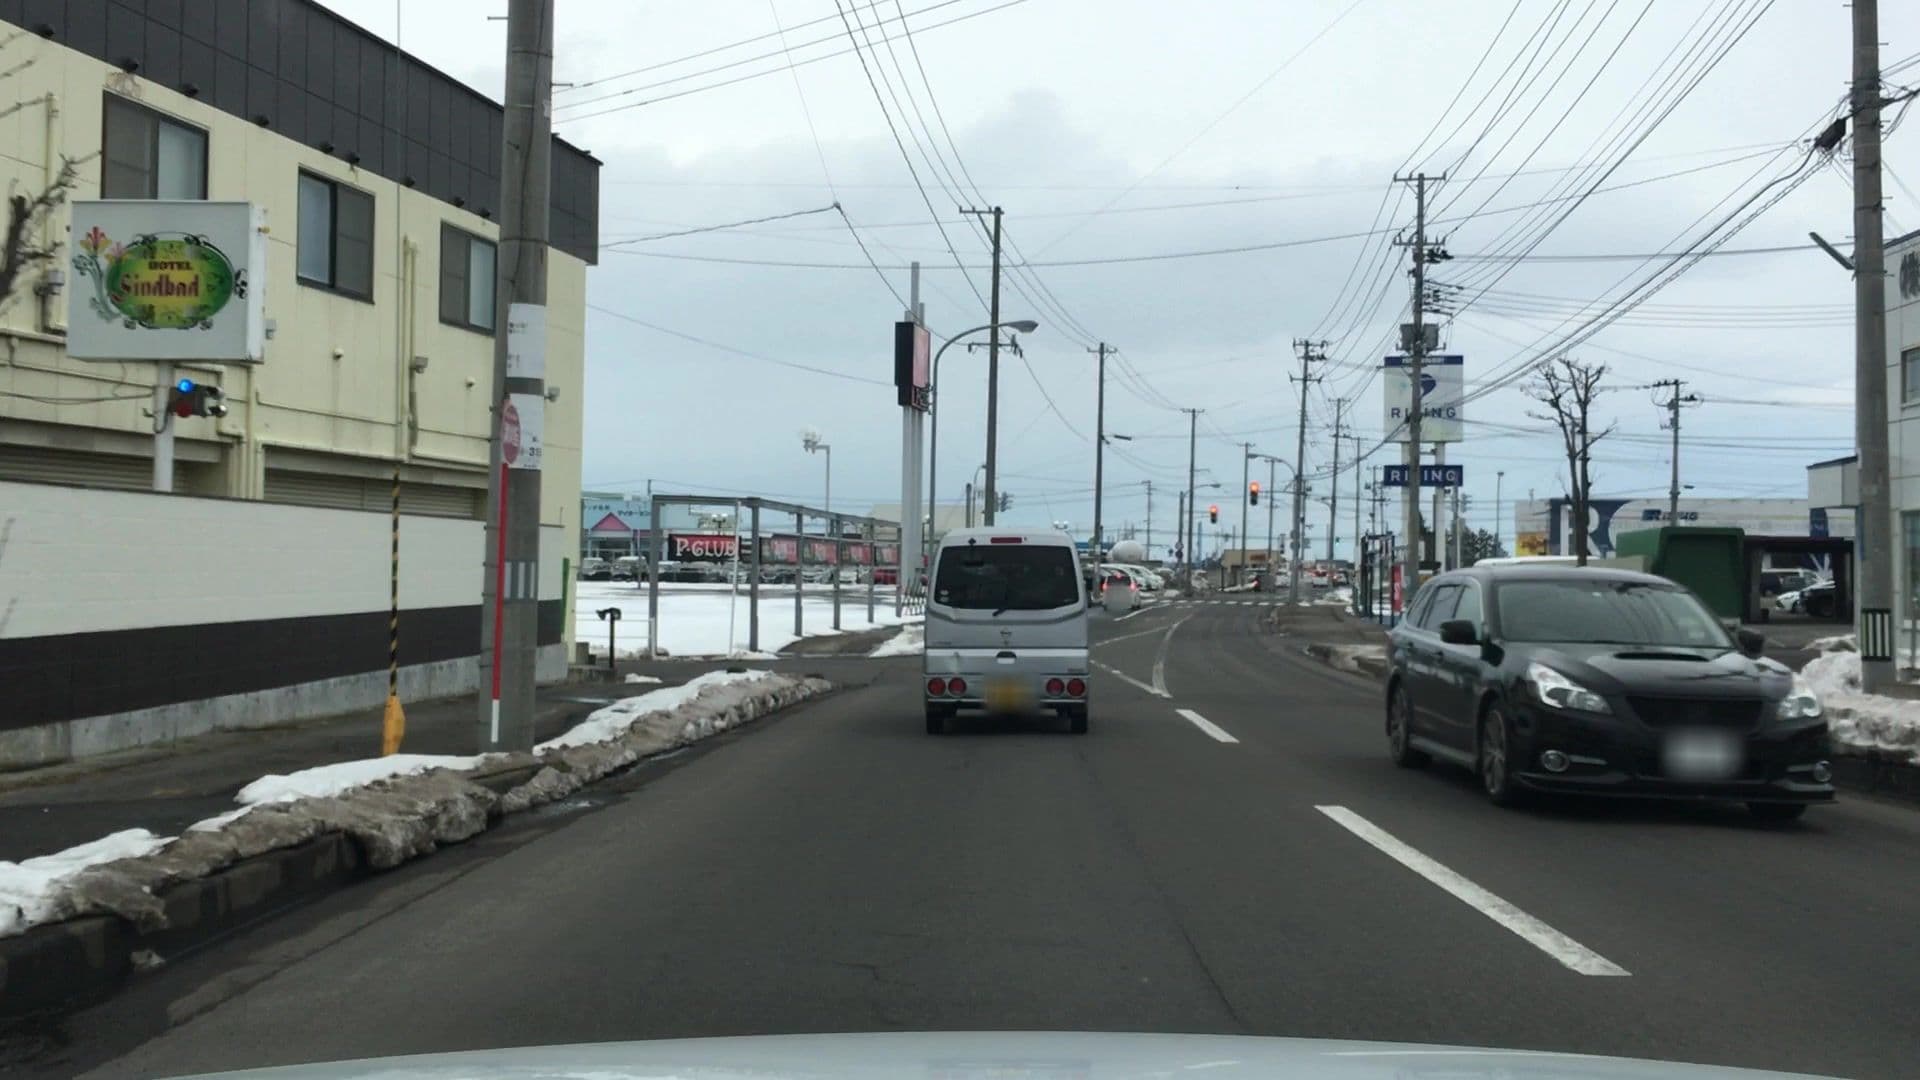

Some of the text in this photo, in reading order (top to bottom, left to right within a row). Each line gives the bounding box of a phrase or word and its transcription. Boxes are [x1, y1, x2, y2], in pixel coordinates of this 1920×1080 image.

[148, 261, 192, 270] HOTEL
[113, 273, 199, 299] Sindbad
[1391, 407, 1456, 418] RIING
[1391, 469, 1456, 481] RIING
